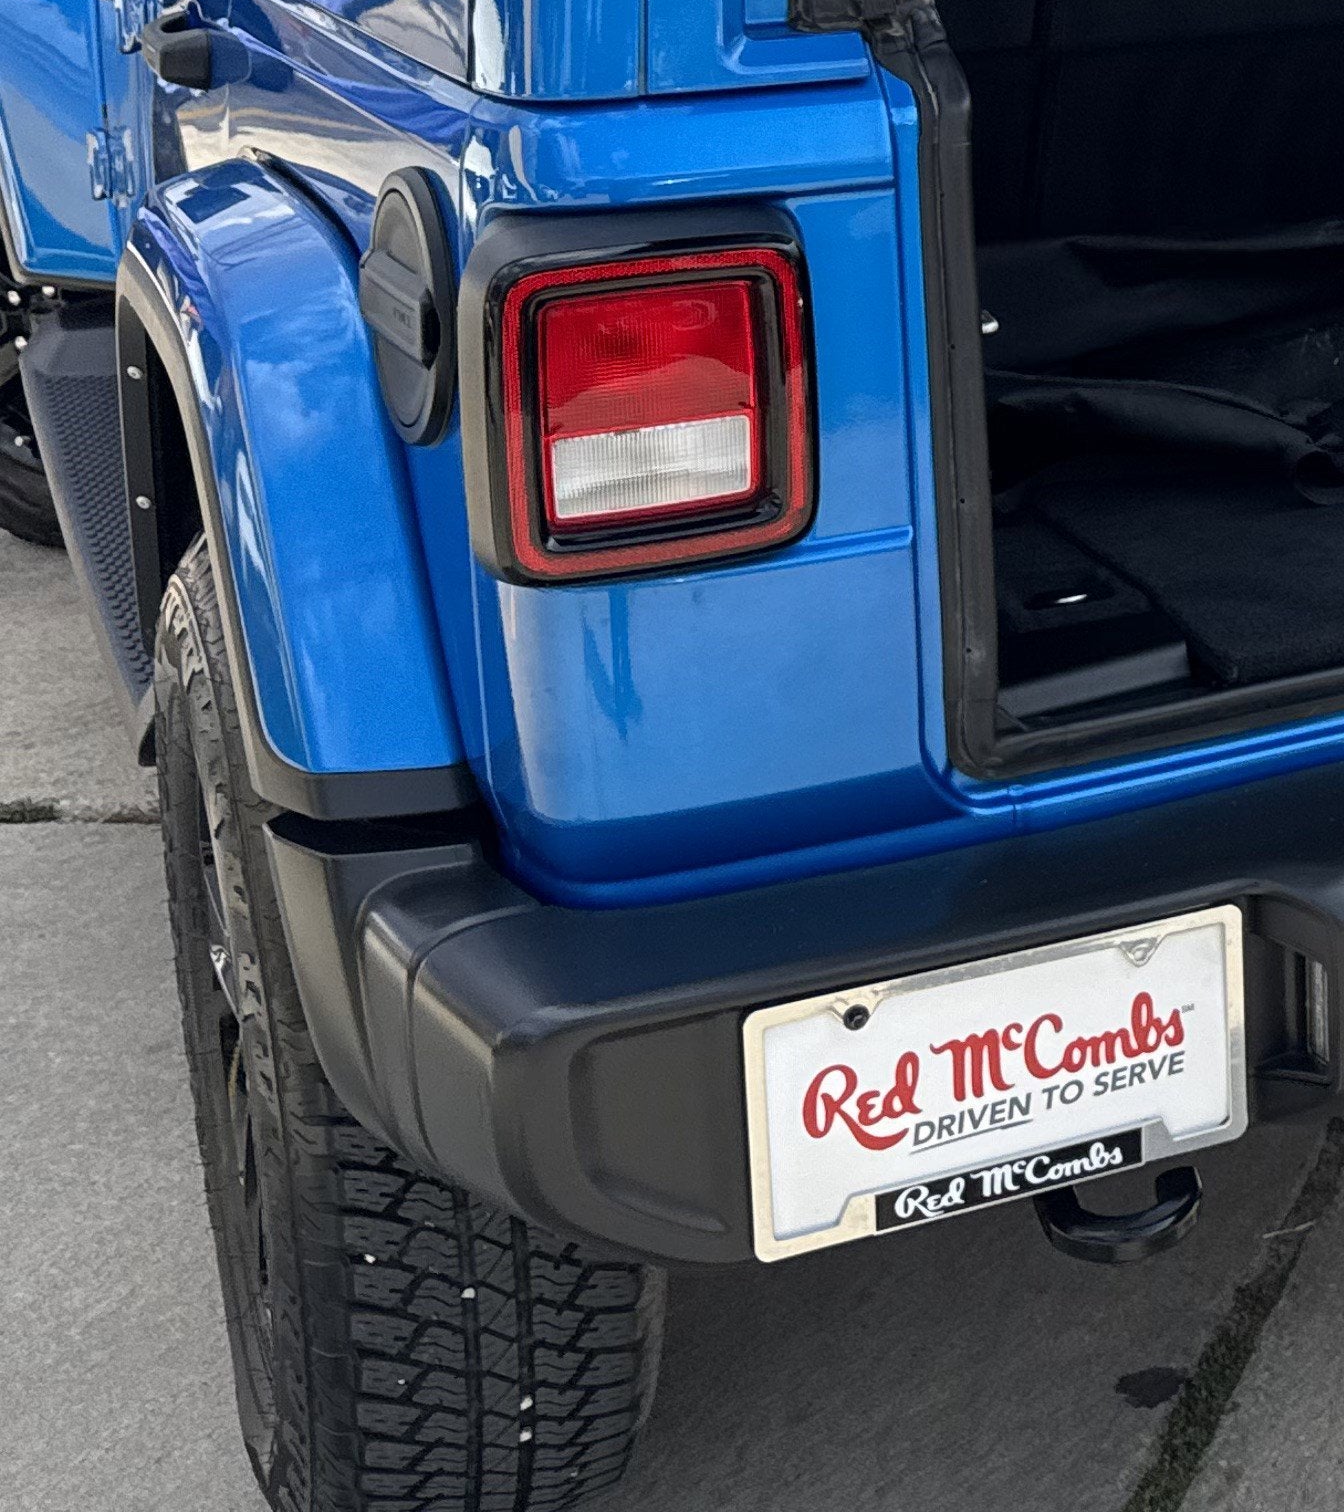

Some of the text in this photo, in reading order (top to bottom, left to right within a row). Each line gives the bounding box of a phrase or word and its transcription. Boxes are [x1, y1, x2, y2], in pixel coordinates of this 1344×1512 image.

[803, 1051, 923, 1150] Red
[929, 991, 1184, 1102] McCombs
[913, 1050, 1185, 1146] DRIVEN TO SERVE
[894, 1141, 1124, 1219] Red McCombs
